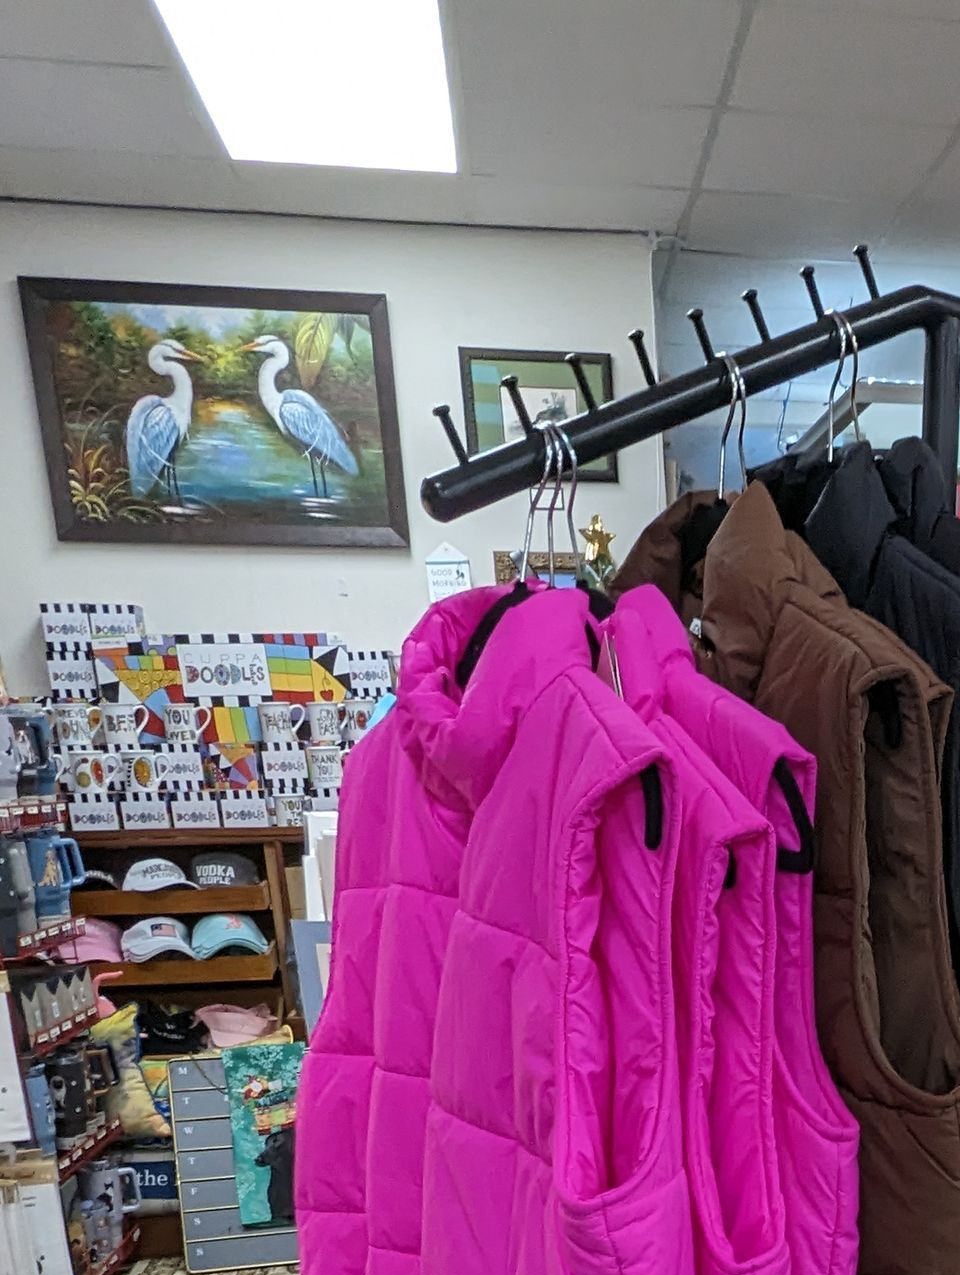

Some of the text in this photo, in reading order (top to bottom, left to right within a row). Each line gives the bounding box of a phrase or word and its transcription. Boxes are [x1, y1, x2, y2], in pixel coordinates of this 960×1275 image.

[182, 653, 263, 664] CUPPA
[184, 662, 266, 686] DOODLES
[165, 708, 190, 725] YOU
[311, 753, 338, 764] THANK
[195, 864, 235, 879] VODKA
[136, 1169, 168, 1187] the
